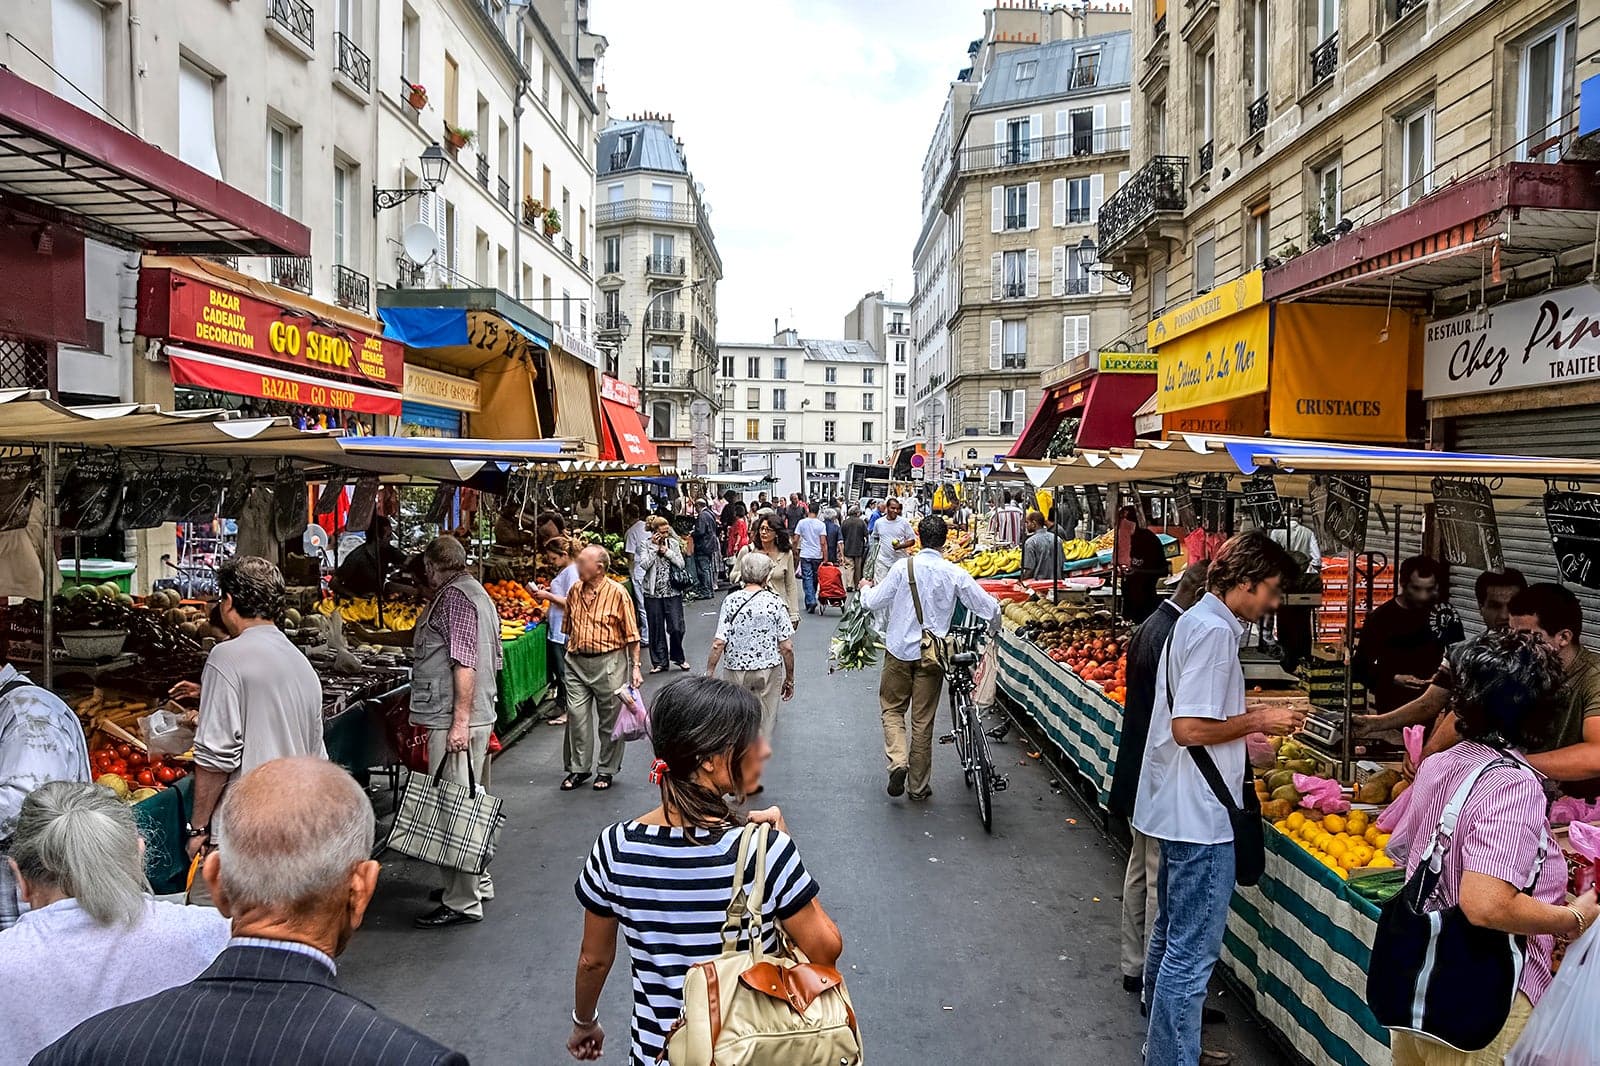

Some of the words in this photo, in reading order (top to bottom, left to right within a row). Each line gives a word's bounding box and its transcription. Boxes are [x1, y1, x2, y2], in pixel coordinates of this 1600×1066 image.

[209, 289, 240, 313] BAZAR
[1174, 295, 1222, 330] POISSONNERIE
[202, 306, 246, 331] CADEAUX
[1427, 313, 1494, 342] RESTAURT
[195, 321, 254, 350] DECORATION
[269, 320, 301, 356] GO
[305, 331, 353, 368] SHOP
[1105, 356, 1158, 369] ÉPICERI
[1164, 364, 1175, 392] Les
[1216, 346, 1230, 378] La
[1234, 339, 1255, 373] Mer
[1448, 333, 1510, 386] Chez
[261, 376, 299, 401] BAZAR
[310, 387, 326, 405] GO
[329, 391, 356, 409] SHOP
[1296, 398, 1381, 417] CRUSTACES
